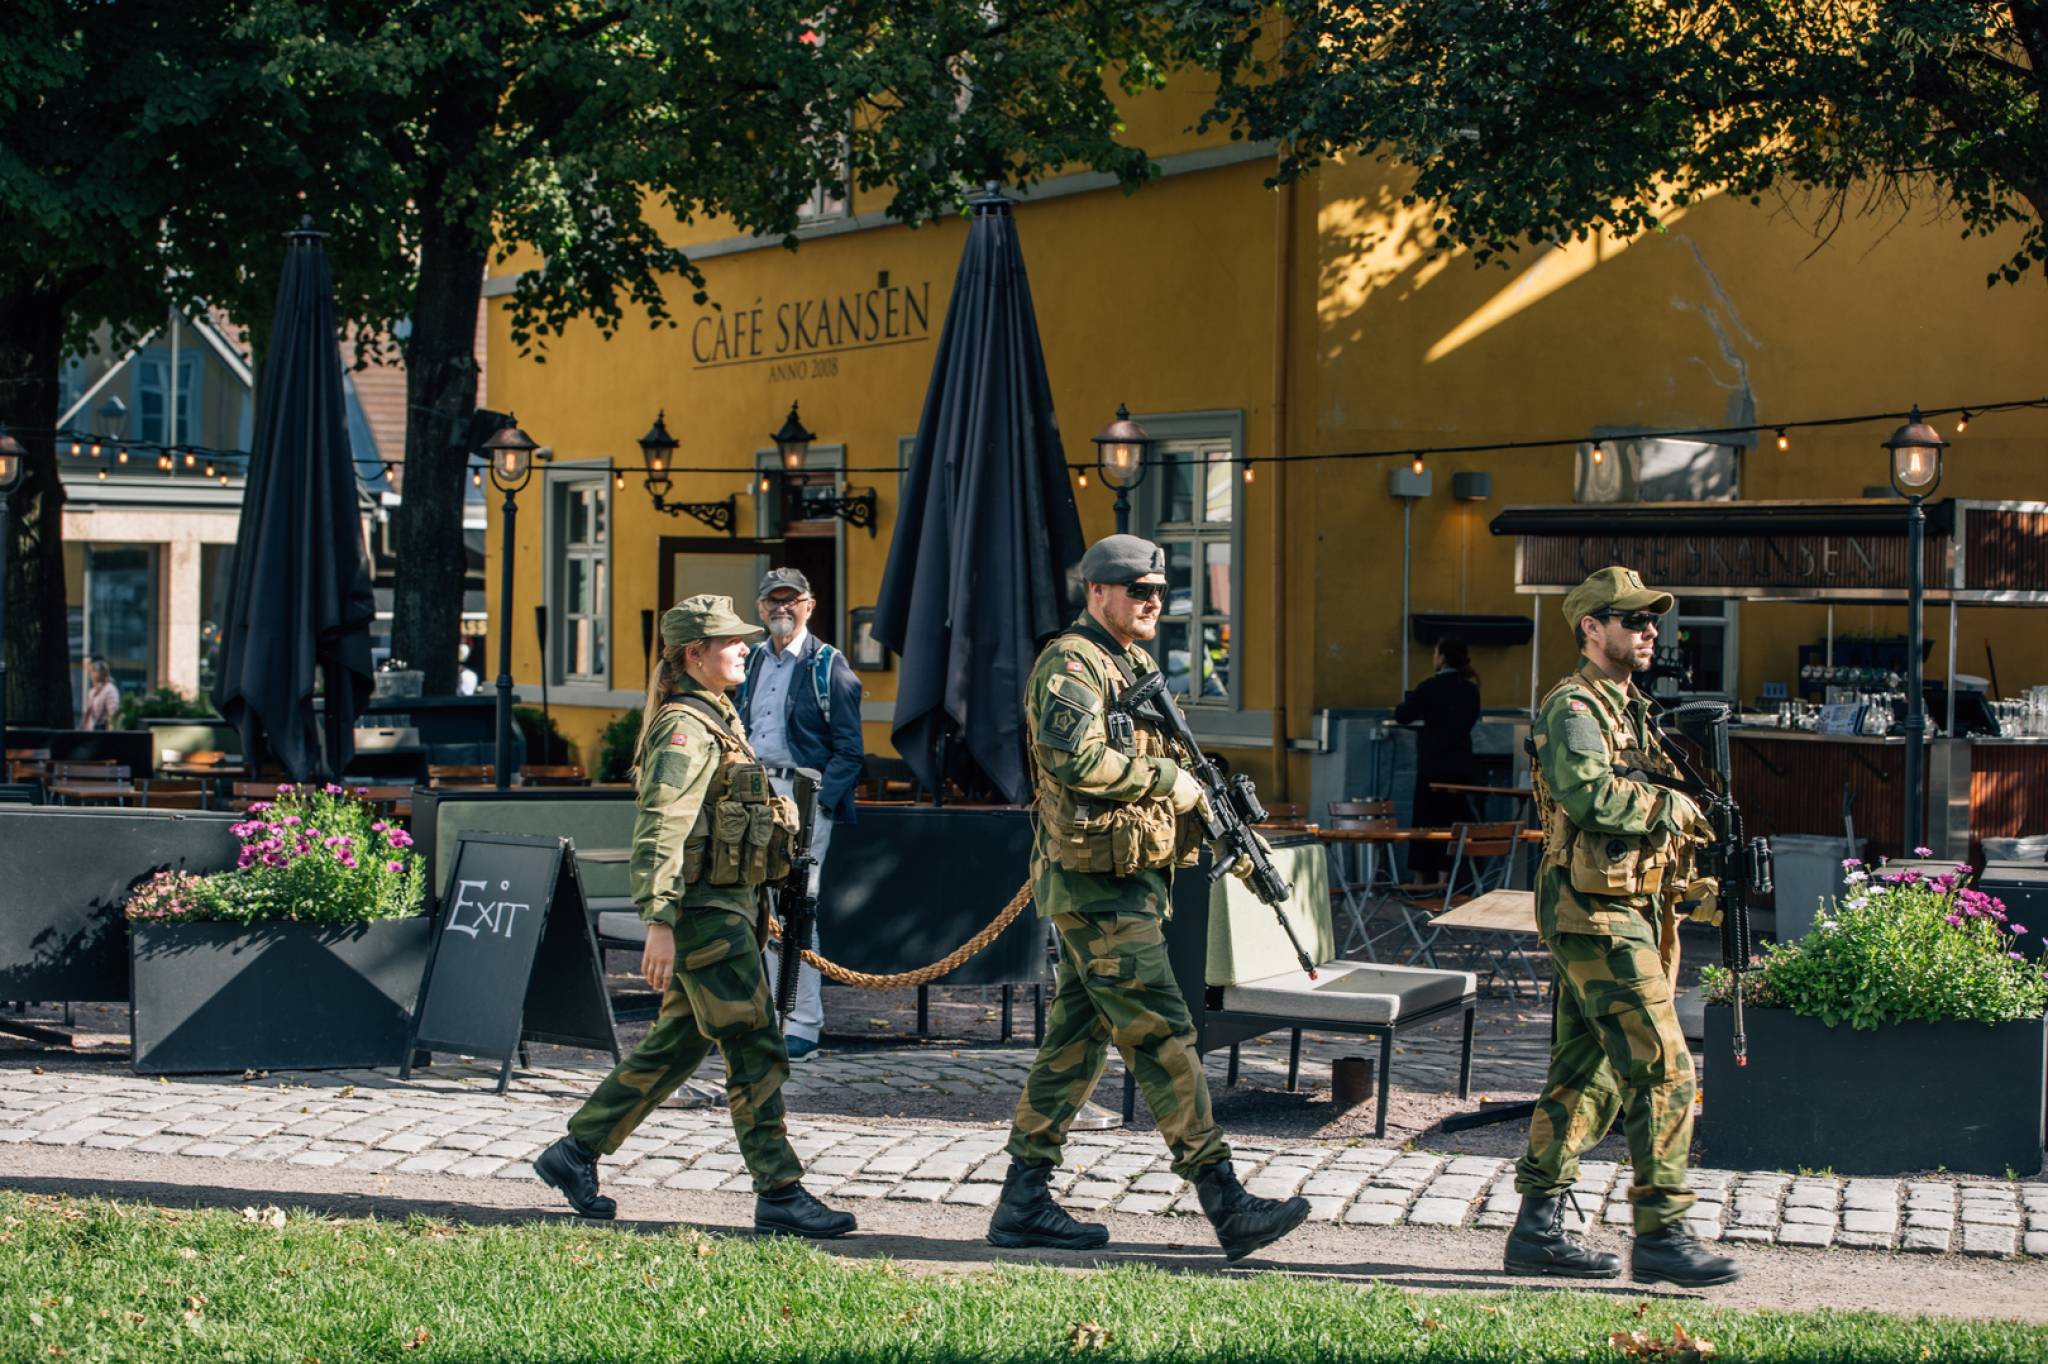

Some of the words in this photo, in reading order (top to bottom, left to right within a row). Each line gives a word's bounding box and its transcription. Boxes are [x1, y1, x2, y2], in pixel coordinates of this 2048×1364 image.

[692, 297, 763, 363] CAFÉ
[775, 281, 931, 353] SKANSEN
[768, 360, 807, 383] ANNO
[811, 357, 839, 378] 2008
